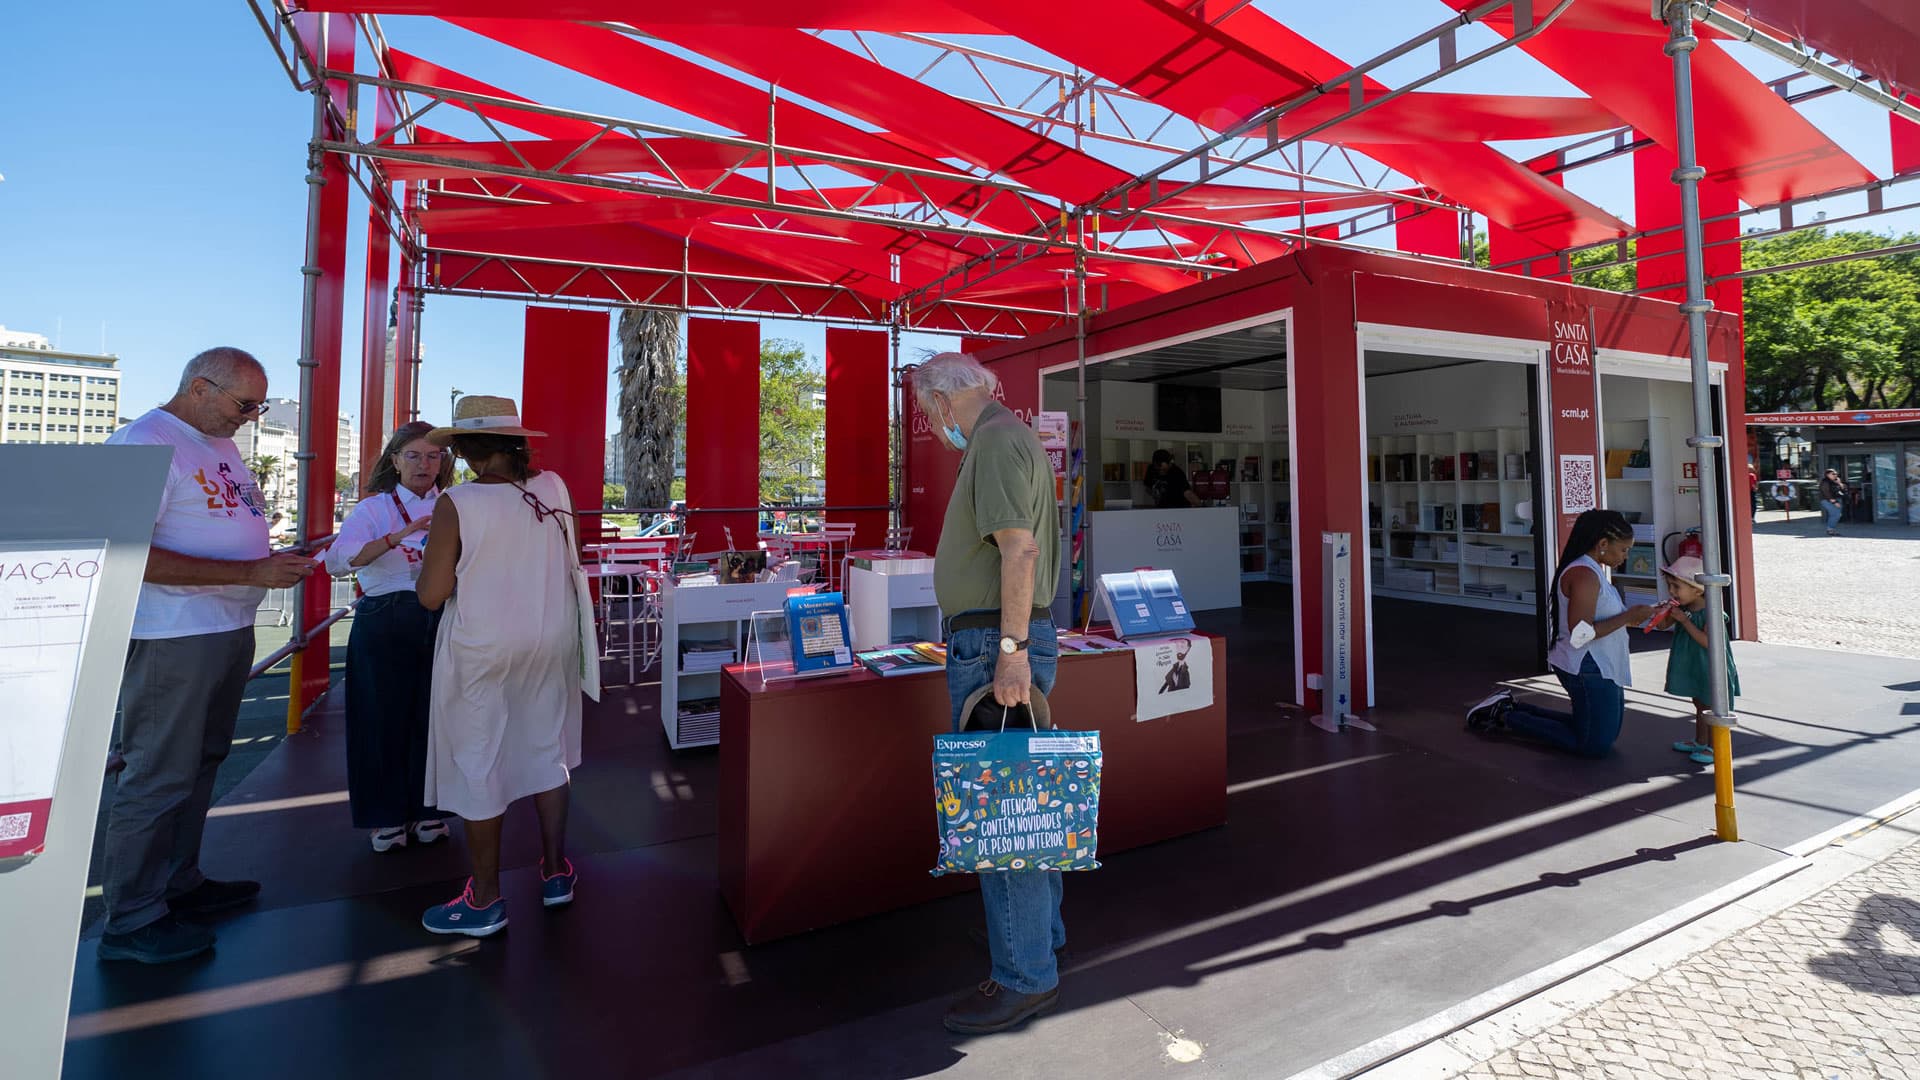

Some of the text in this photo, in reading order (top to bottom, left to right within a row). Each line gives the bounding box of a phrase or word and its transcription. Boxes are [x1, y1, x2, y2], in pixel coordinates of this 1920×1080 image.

[1554, 320, 1588, 341] SANTA
[1555, 343, 1590, 365] CASA
[1561, 407, 1589, 420] scml.pt
[1156, 522, 1182, 532] SANTA
[1156, 535, 1182, 547] CASA
[936, 739, 986, 751] Expresso
[981, 812, 1062, 837] CONTÉM NOVIDADES
[978, 831, 1064, 856] DE PESO NO INTERIOR
